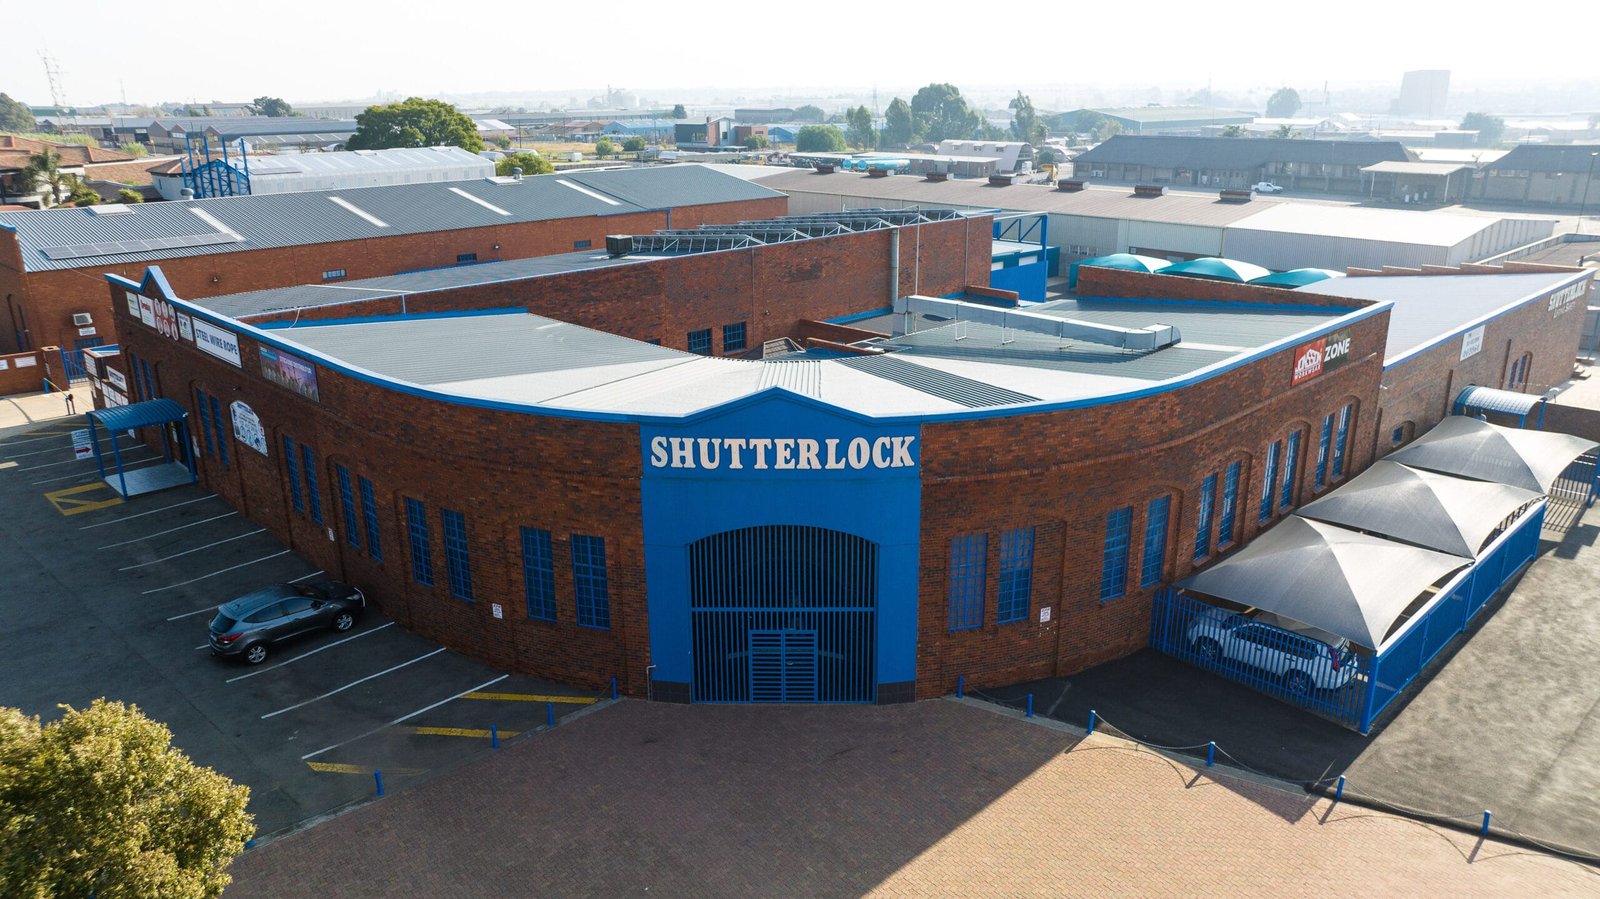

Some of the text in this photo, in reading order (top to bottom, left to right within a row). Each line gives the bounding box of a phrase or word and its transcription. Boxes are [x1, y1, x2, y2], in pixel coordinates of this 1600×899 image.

[196, 329, 238, 356] STEEL WIRE ROPE
[1324, 338, 1351, 362] ZONE
[650, 436, 915, 469] SHUTTERLOCK
